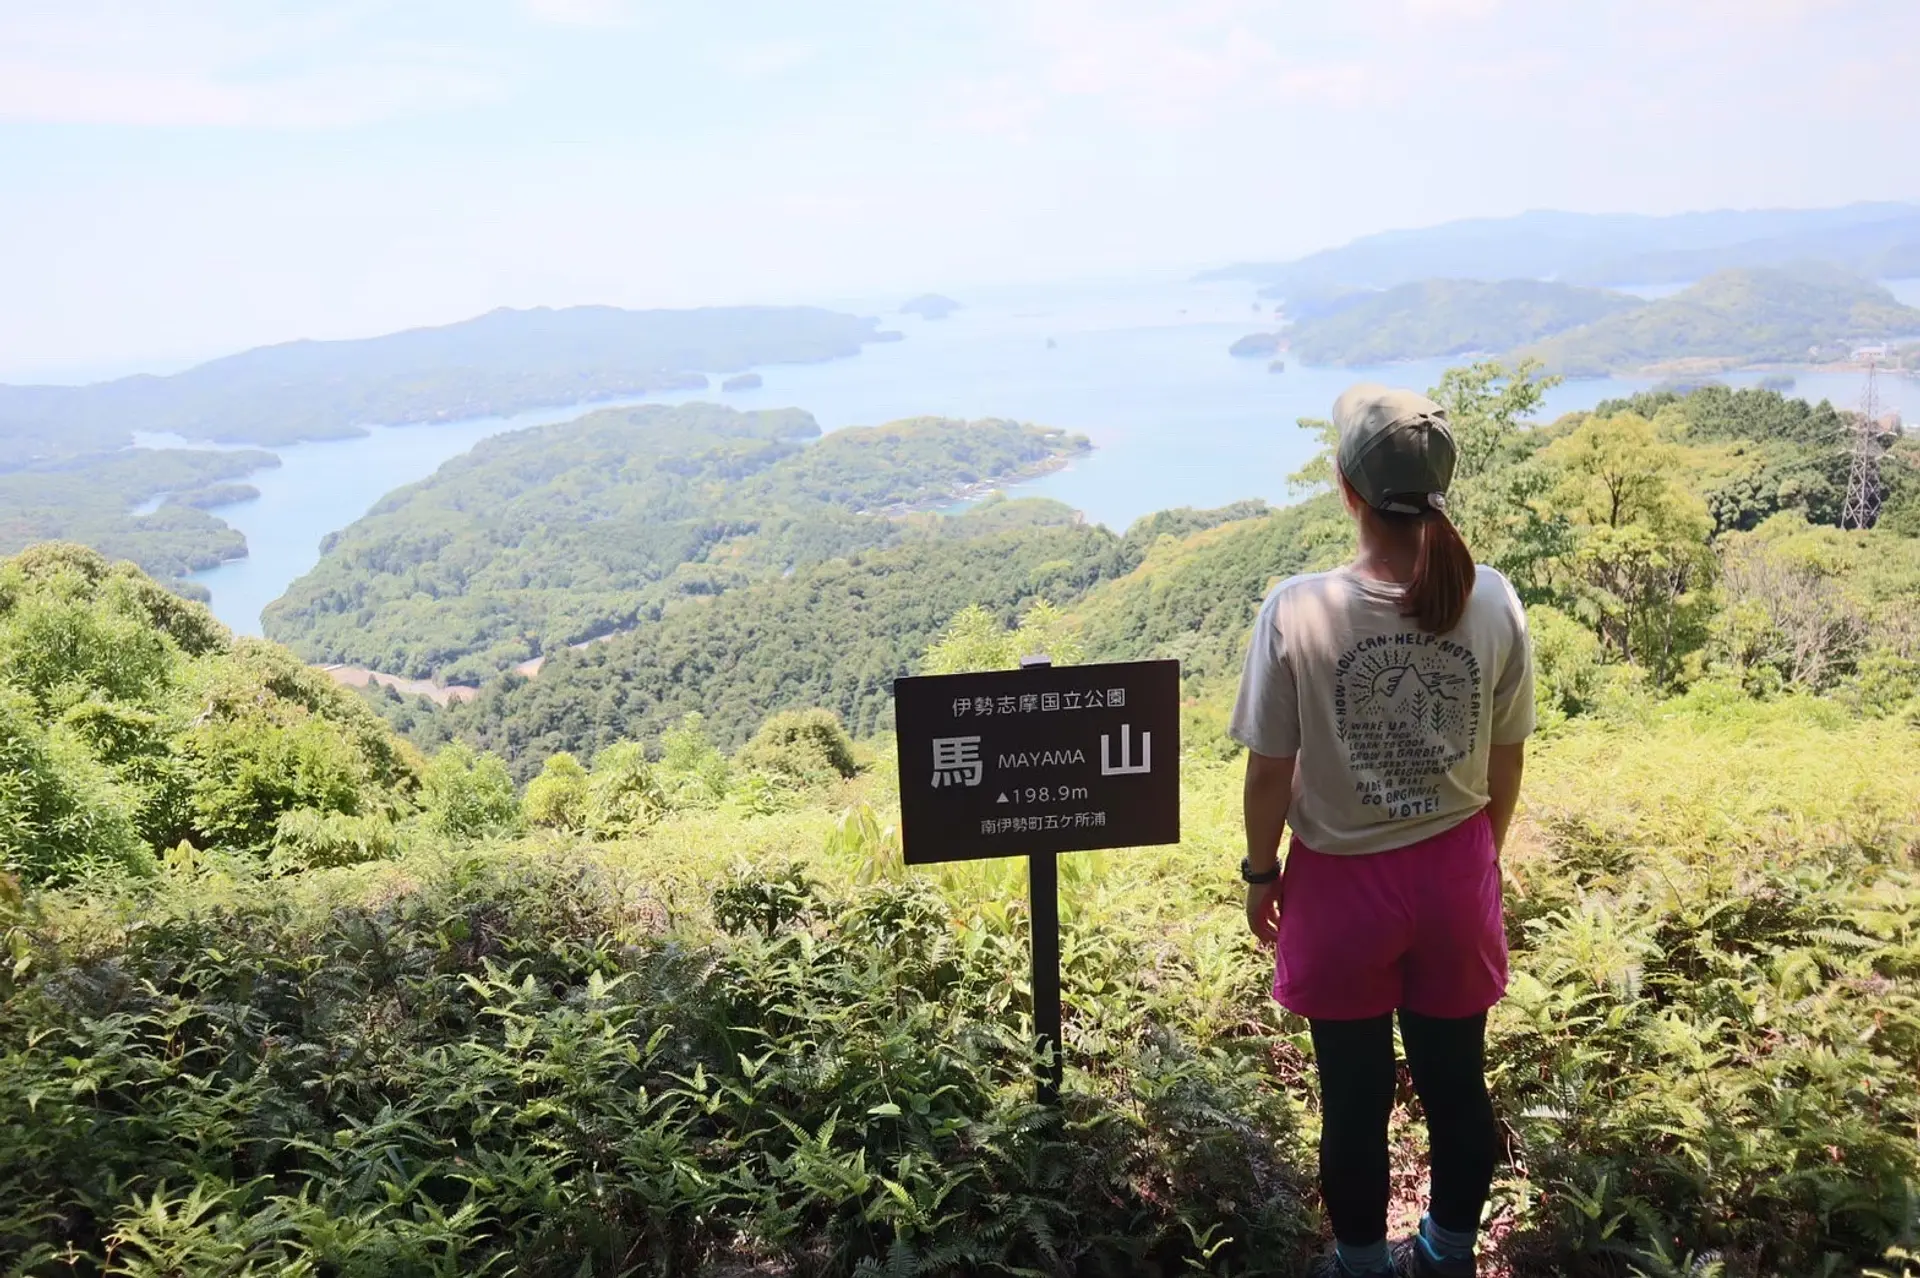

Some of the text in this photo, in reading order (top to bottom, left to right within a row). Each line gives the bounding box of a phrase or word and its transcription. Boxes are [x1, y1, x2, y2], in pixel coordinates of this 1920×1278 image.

[1336, 633, 1481, 736] HOW YOU CAN HELP MOTHER EARTH
[952, 688, 1126, 718] 伊勢志摩国立公園
[1351, 721, 1408, 731] WAKE UP
[1349, 739, 1425, 750] LEARN TO COOK
[1350, 745, 1445, 762] GROW A GARDEN
[931, 724, 1152, 788] 馬 MAYAMA 山
[1411, 759, 1440, 768] WITH
[1355, 781, 1382, 793] RIDE
[1385, 778, 1393, 789] A
[1361, 784, 1440, 805] GO ORGANIC
[1013, 786, 1088, 804] 198.9m
[1388, 798, 1440, 819] VOTE!
